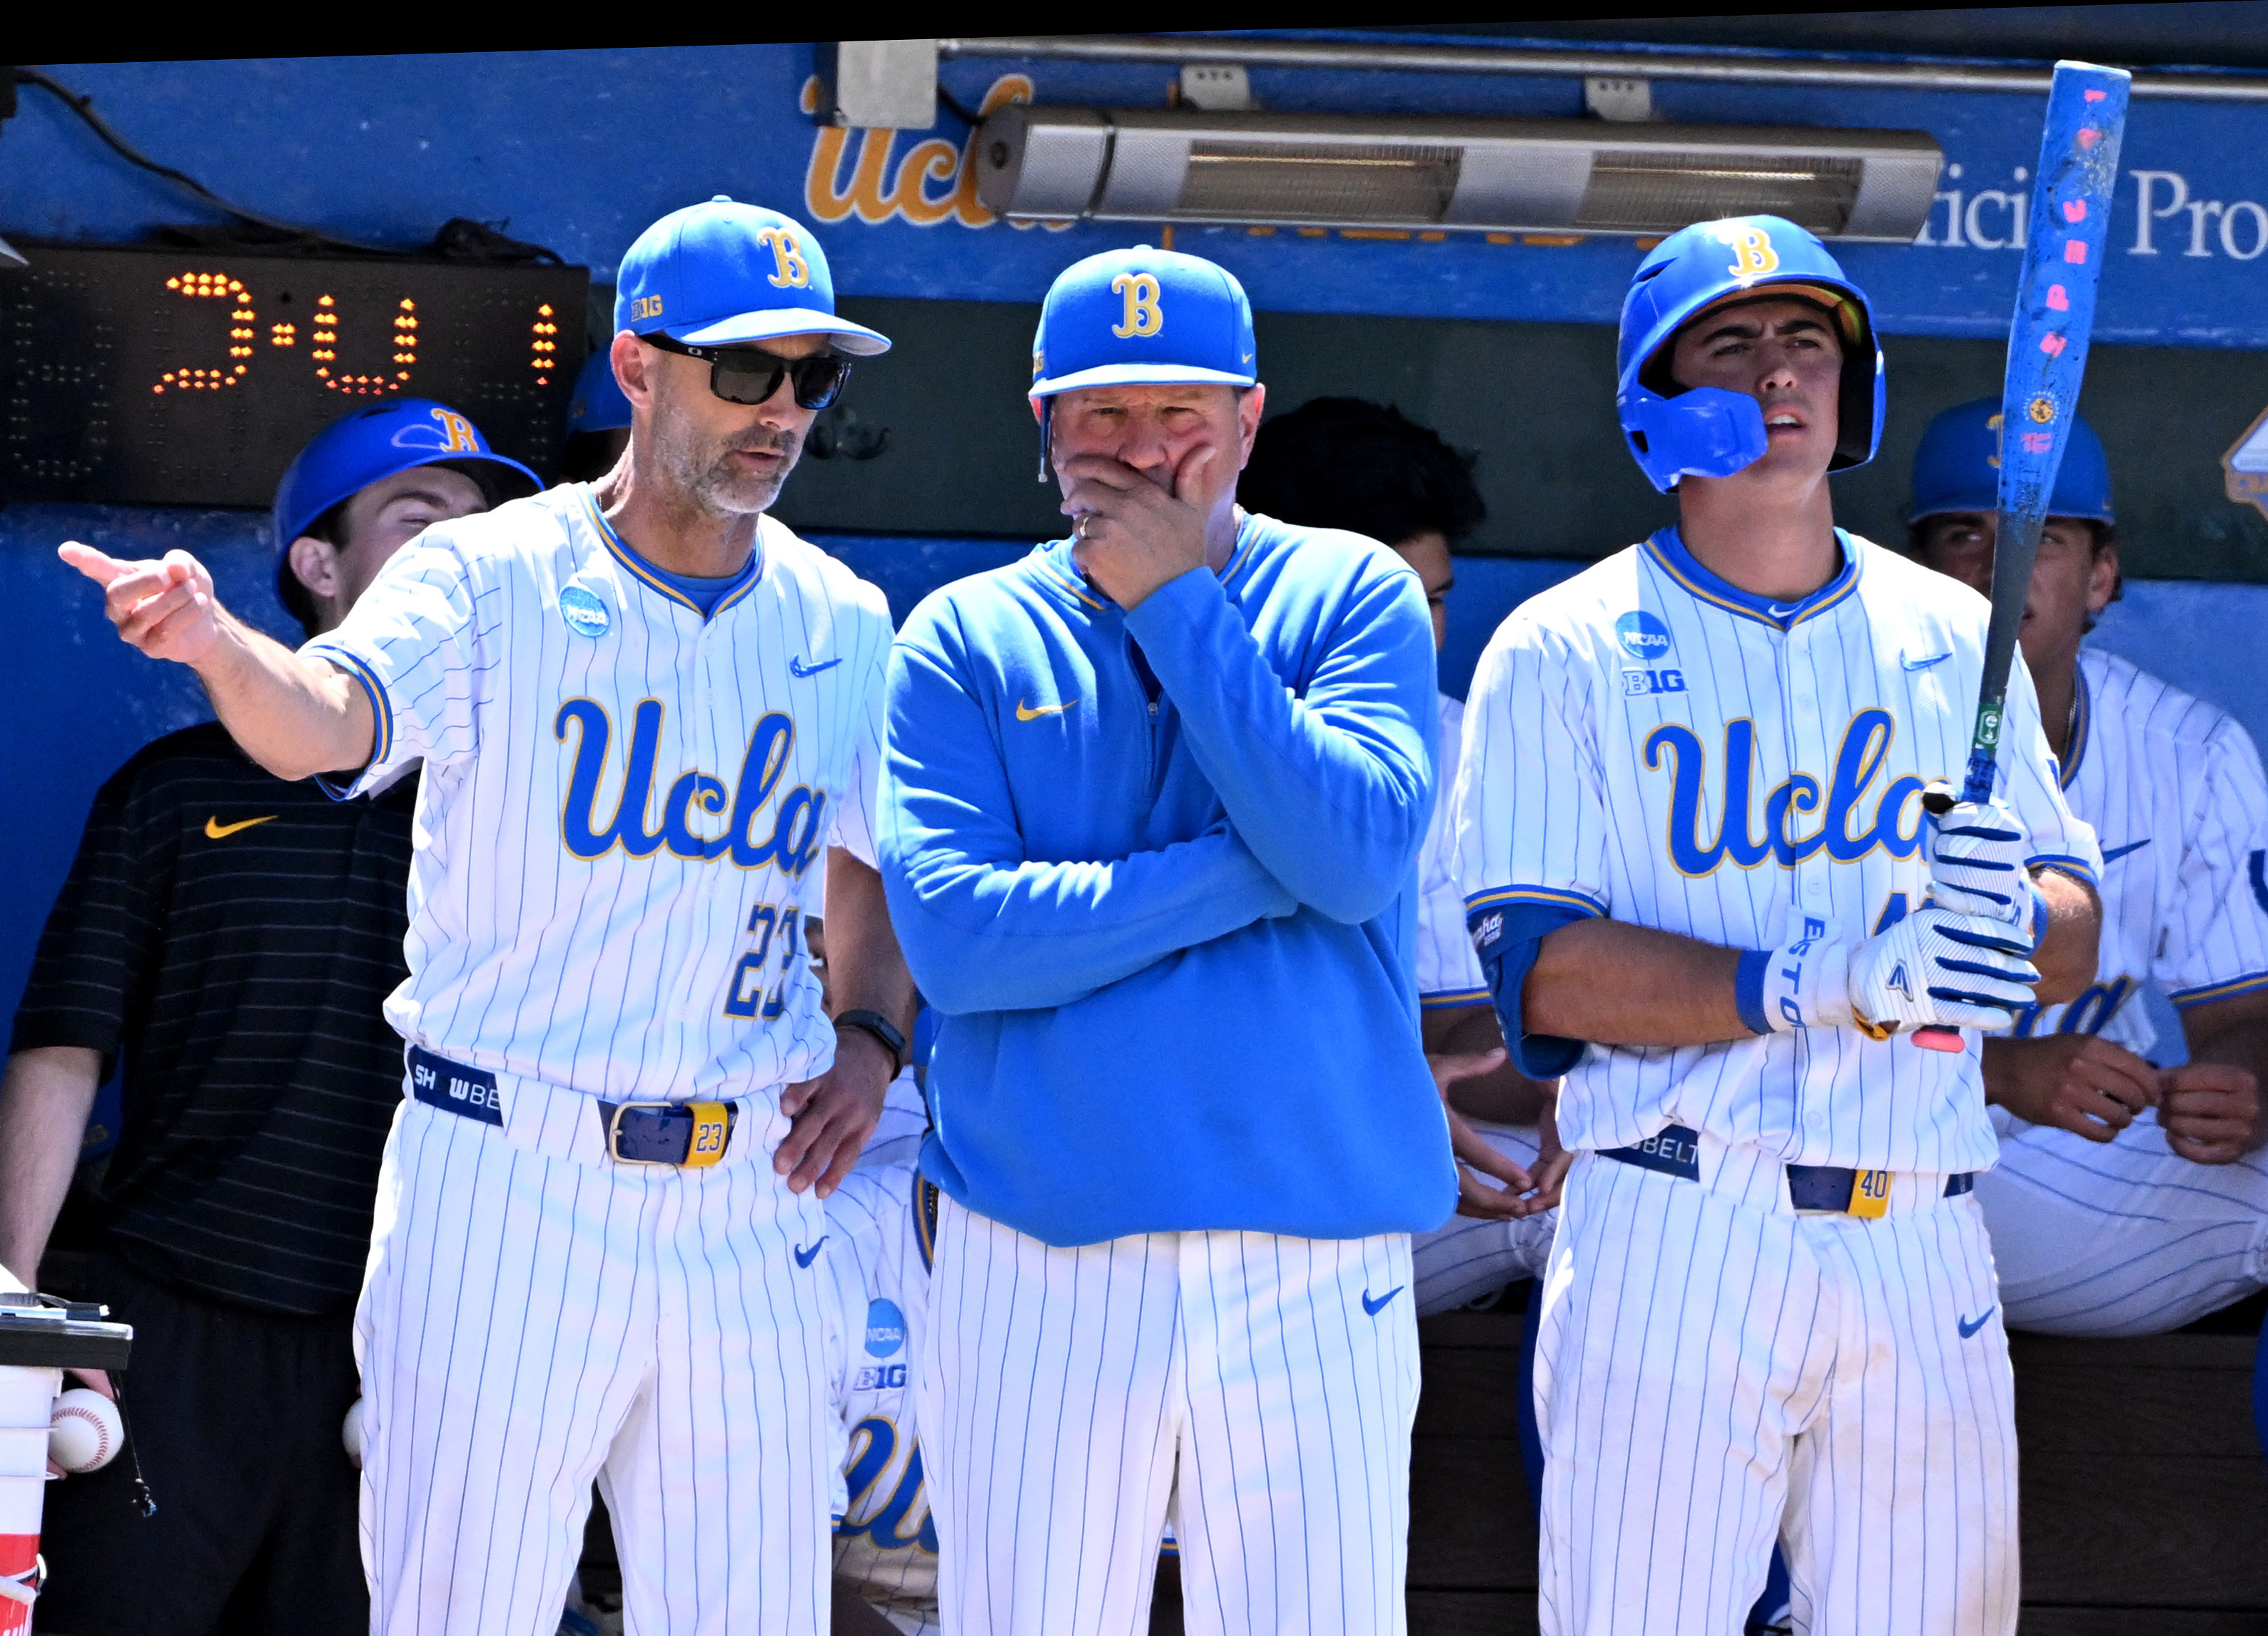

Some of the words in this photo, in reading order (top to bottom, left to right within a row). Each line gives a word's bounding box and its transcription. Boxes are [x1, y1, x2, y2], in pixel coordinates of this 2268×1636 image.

[756, 226, 809, 288] B
[1721, 227, 1779, 278] B
[1111, 273, 1163, 339] B
[1623, 631, 1669, 646] NCAA
[554, 696, 826, 880] Ucla
[722, 902, 801, 1022] 23
[695, 1122, 722, 1152] 23
[1631, 1137, 1698, 1164] BELT
[1860, 1169, 1888, 1199] 40
